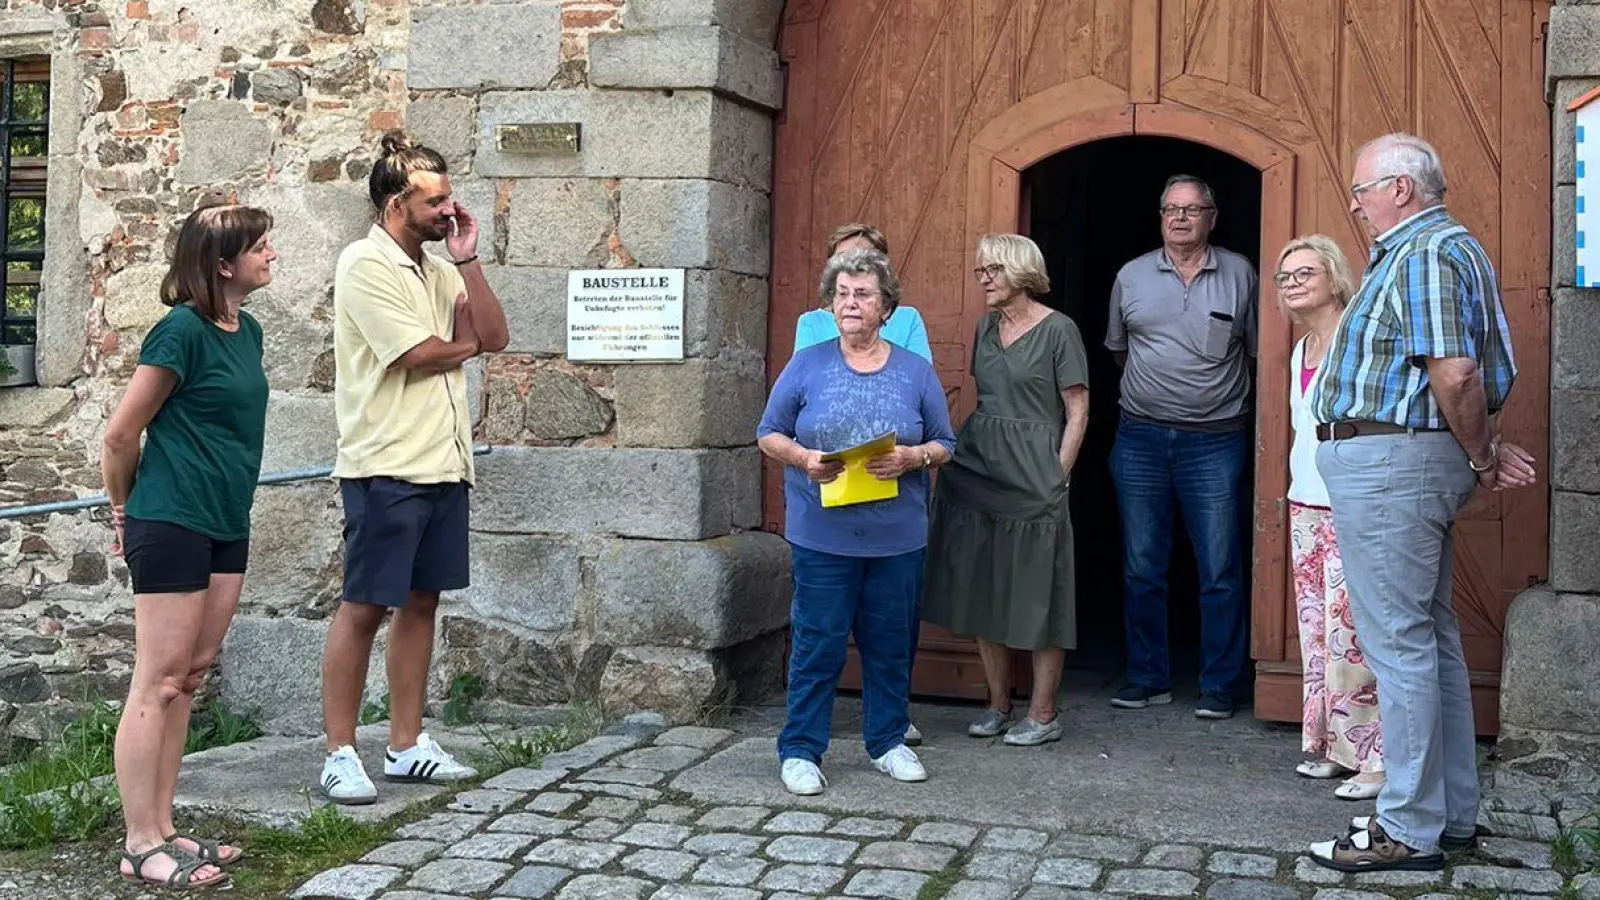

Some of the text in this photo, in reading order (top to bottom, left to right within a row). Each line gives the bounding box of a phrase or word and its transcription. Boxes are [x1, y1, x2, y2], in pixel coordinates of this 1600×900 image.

[582, 276, 669, 288] BAUSTELLE
[624, 294, 662, 302] Baustelle
[584, 305, 625, 313] Unbefugte
